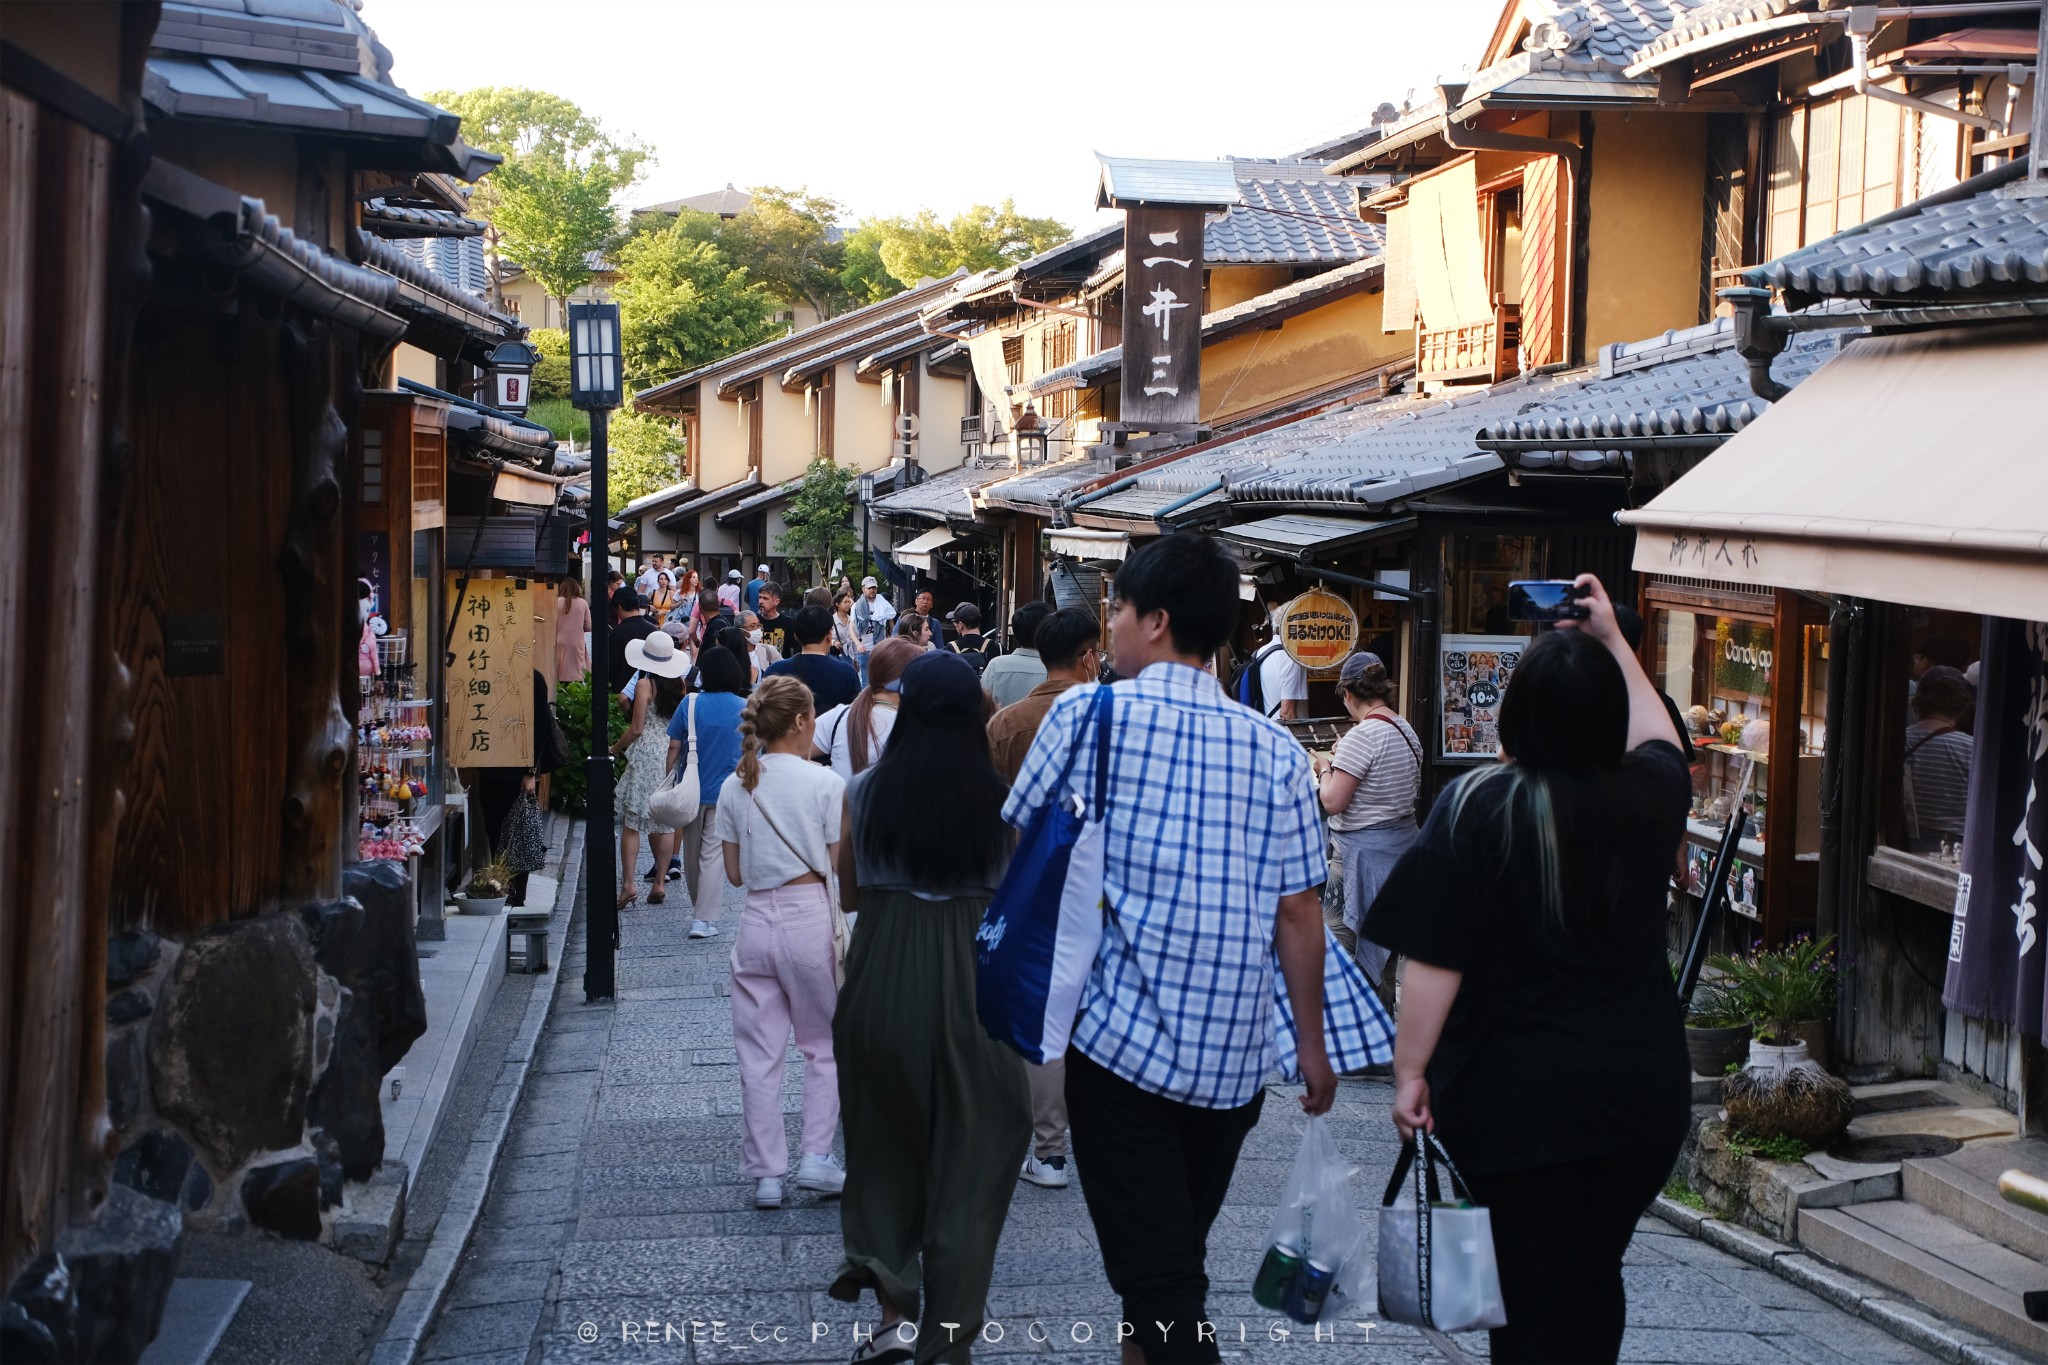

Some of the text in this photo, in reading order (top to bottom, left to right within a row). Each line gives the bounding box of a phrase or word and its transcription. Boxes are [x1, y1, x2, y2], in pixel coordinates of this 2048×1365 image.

[504, 586, 516, 625] 製造元
[1288, 623, 1350, 641] 見るだけOK!!
[1725, 638, 1759, 671] Candy
[467, 594, 491, 752] 神田竹細工店
[1470, 691, 1496, 704] 10分
